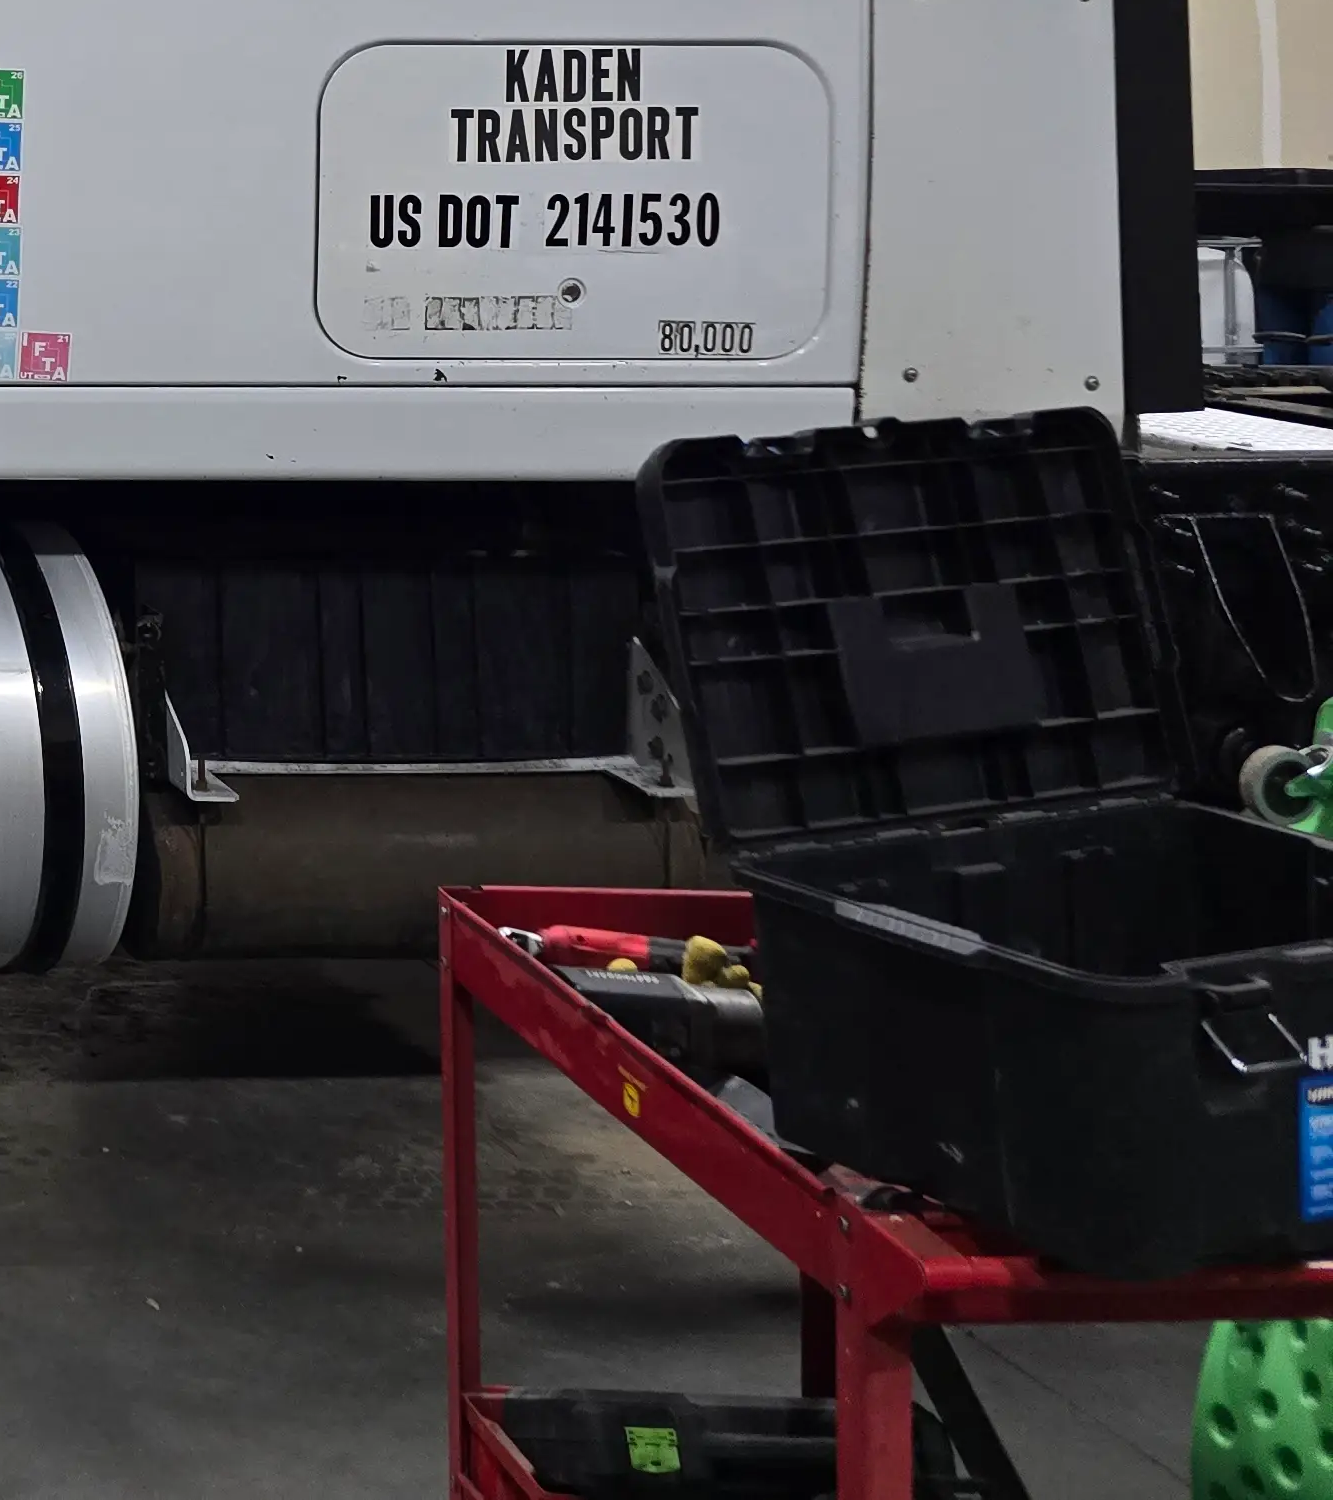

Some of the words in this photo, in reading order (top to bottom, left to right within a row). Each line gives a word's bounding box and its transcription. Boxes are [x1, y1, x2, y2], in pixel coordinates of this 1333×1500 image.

[10, 72, 23, 80] 26
[505, 48, 642, 103] KADEN
[8, 124, 21, 132] 25
[450, 106, 699, 163] TRANSPORT
[6, 177, 19, 185] 24
[368, 193, 422, 248] US
[437, 194, 520, 249] DOT
[544, 192, 721, 248] 2141530
[8, 228, 21, 236] 23
[57, 335, 69, 343] 21
[659, 321, 754, 357] 80,000
[20, 371, 34, 379] UT
